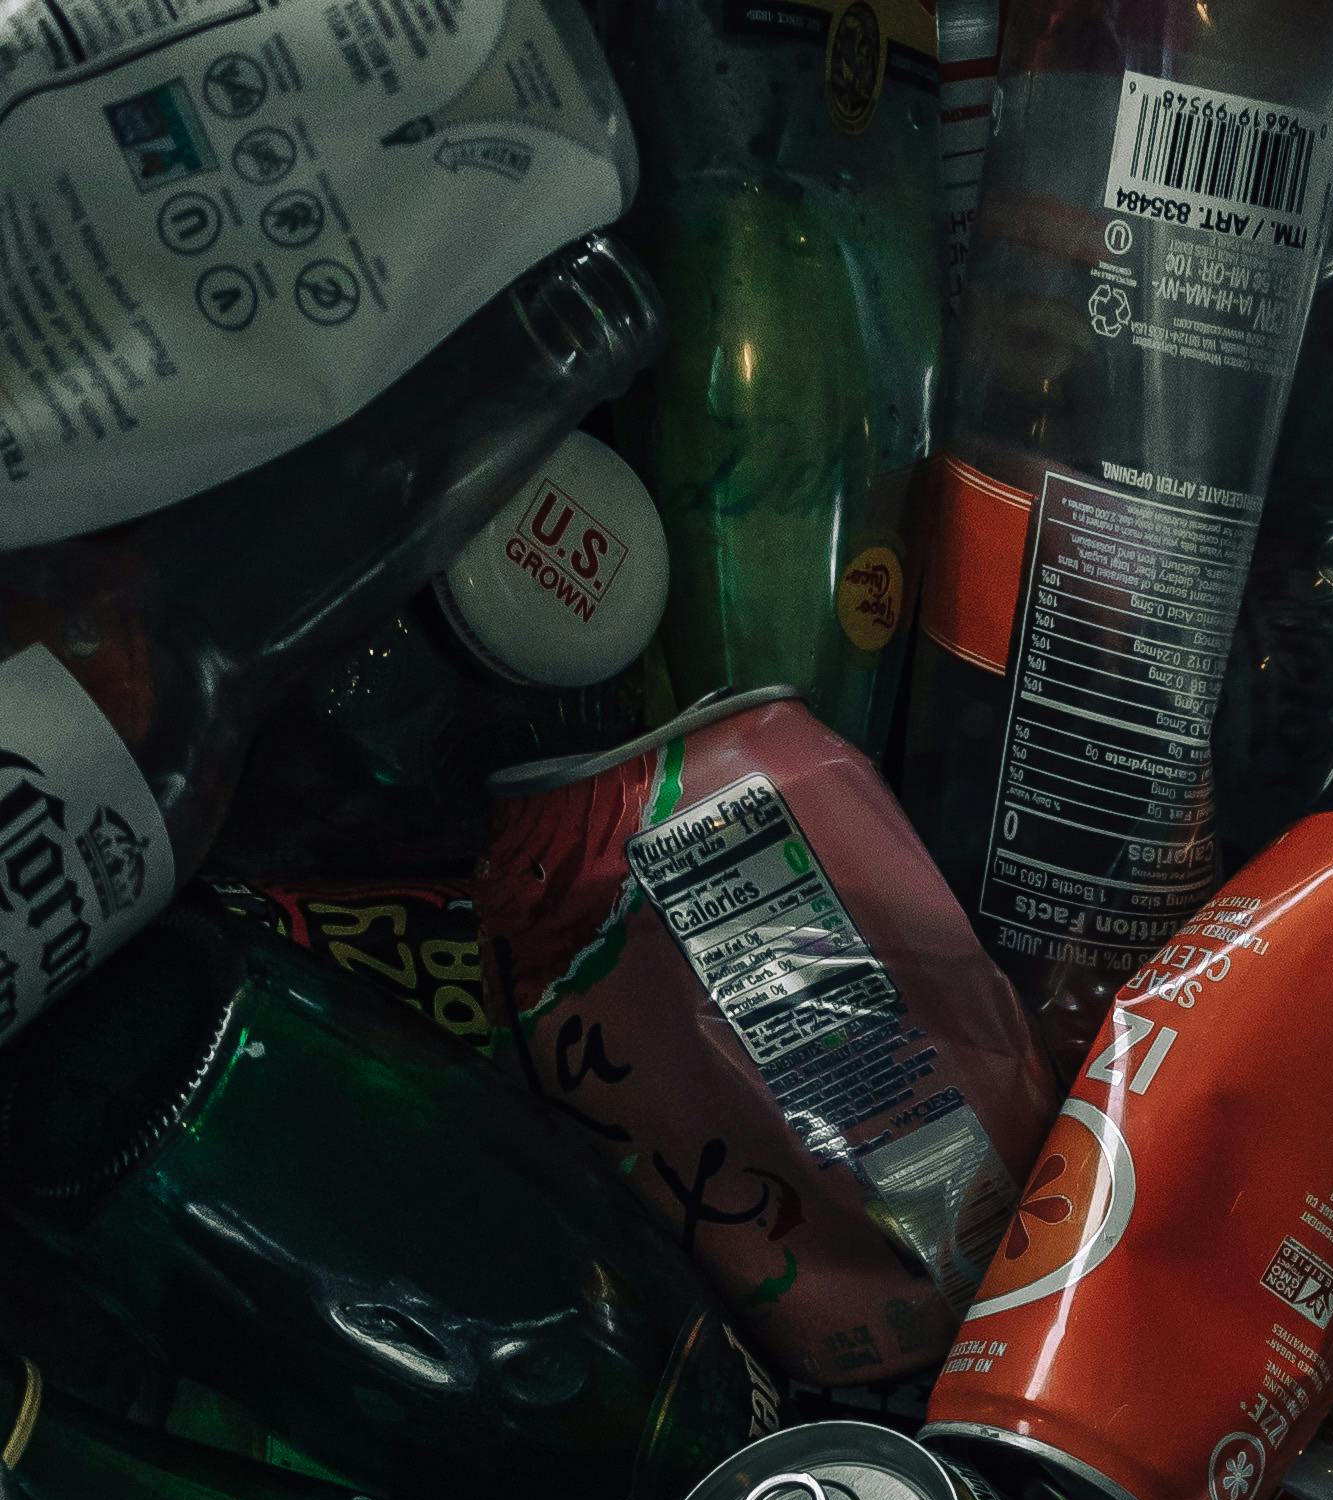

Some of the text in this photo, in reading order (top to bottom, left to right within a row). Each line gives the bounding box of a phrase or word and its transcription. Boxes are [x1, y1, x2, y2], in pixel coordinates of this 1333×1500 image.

[1162, 90, 1228, 121] 99548
[1117, 188, 1307, 250] ITM. ART. 835484
[1101, 461, 1195, 499] AFTER OPENING.
[531, 490, 607, 592] U.S.
[505, 538, 598, 623] GROWN
[1041, 569, 1061, 587] 10%
[1085, 744, 1197, 783] Carbohydrate 0g
[631, 785, 774, 866] Nutrition Facts
[1019, 867, 1096, 901] Bottle (503
[670, 881, 761, 932] Calories
[1015, 895, 1086, 935] Facts
[999, 926, 1098, 969] FRUIT JUICE
[1267, 1274, 1296, 1302] NON
[1271, 1263, 1300, 1290] GMO
